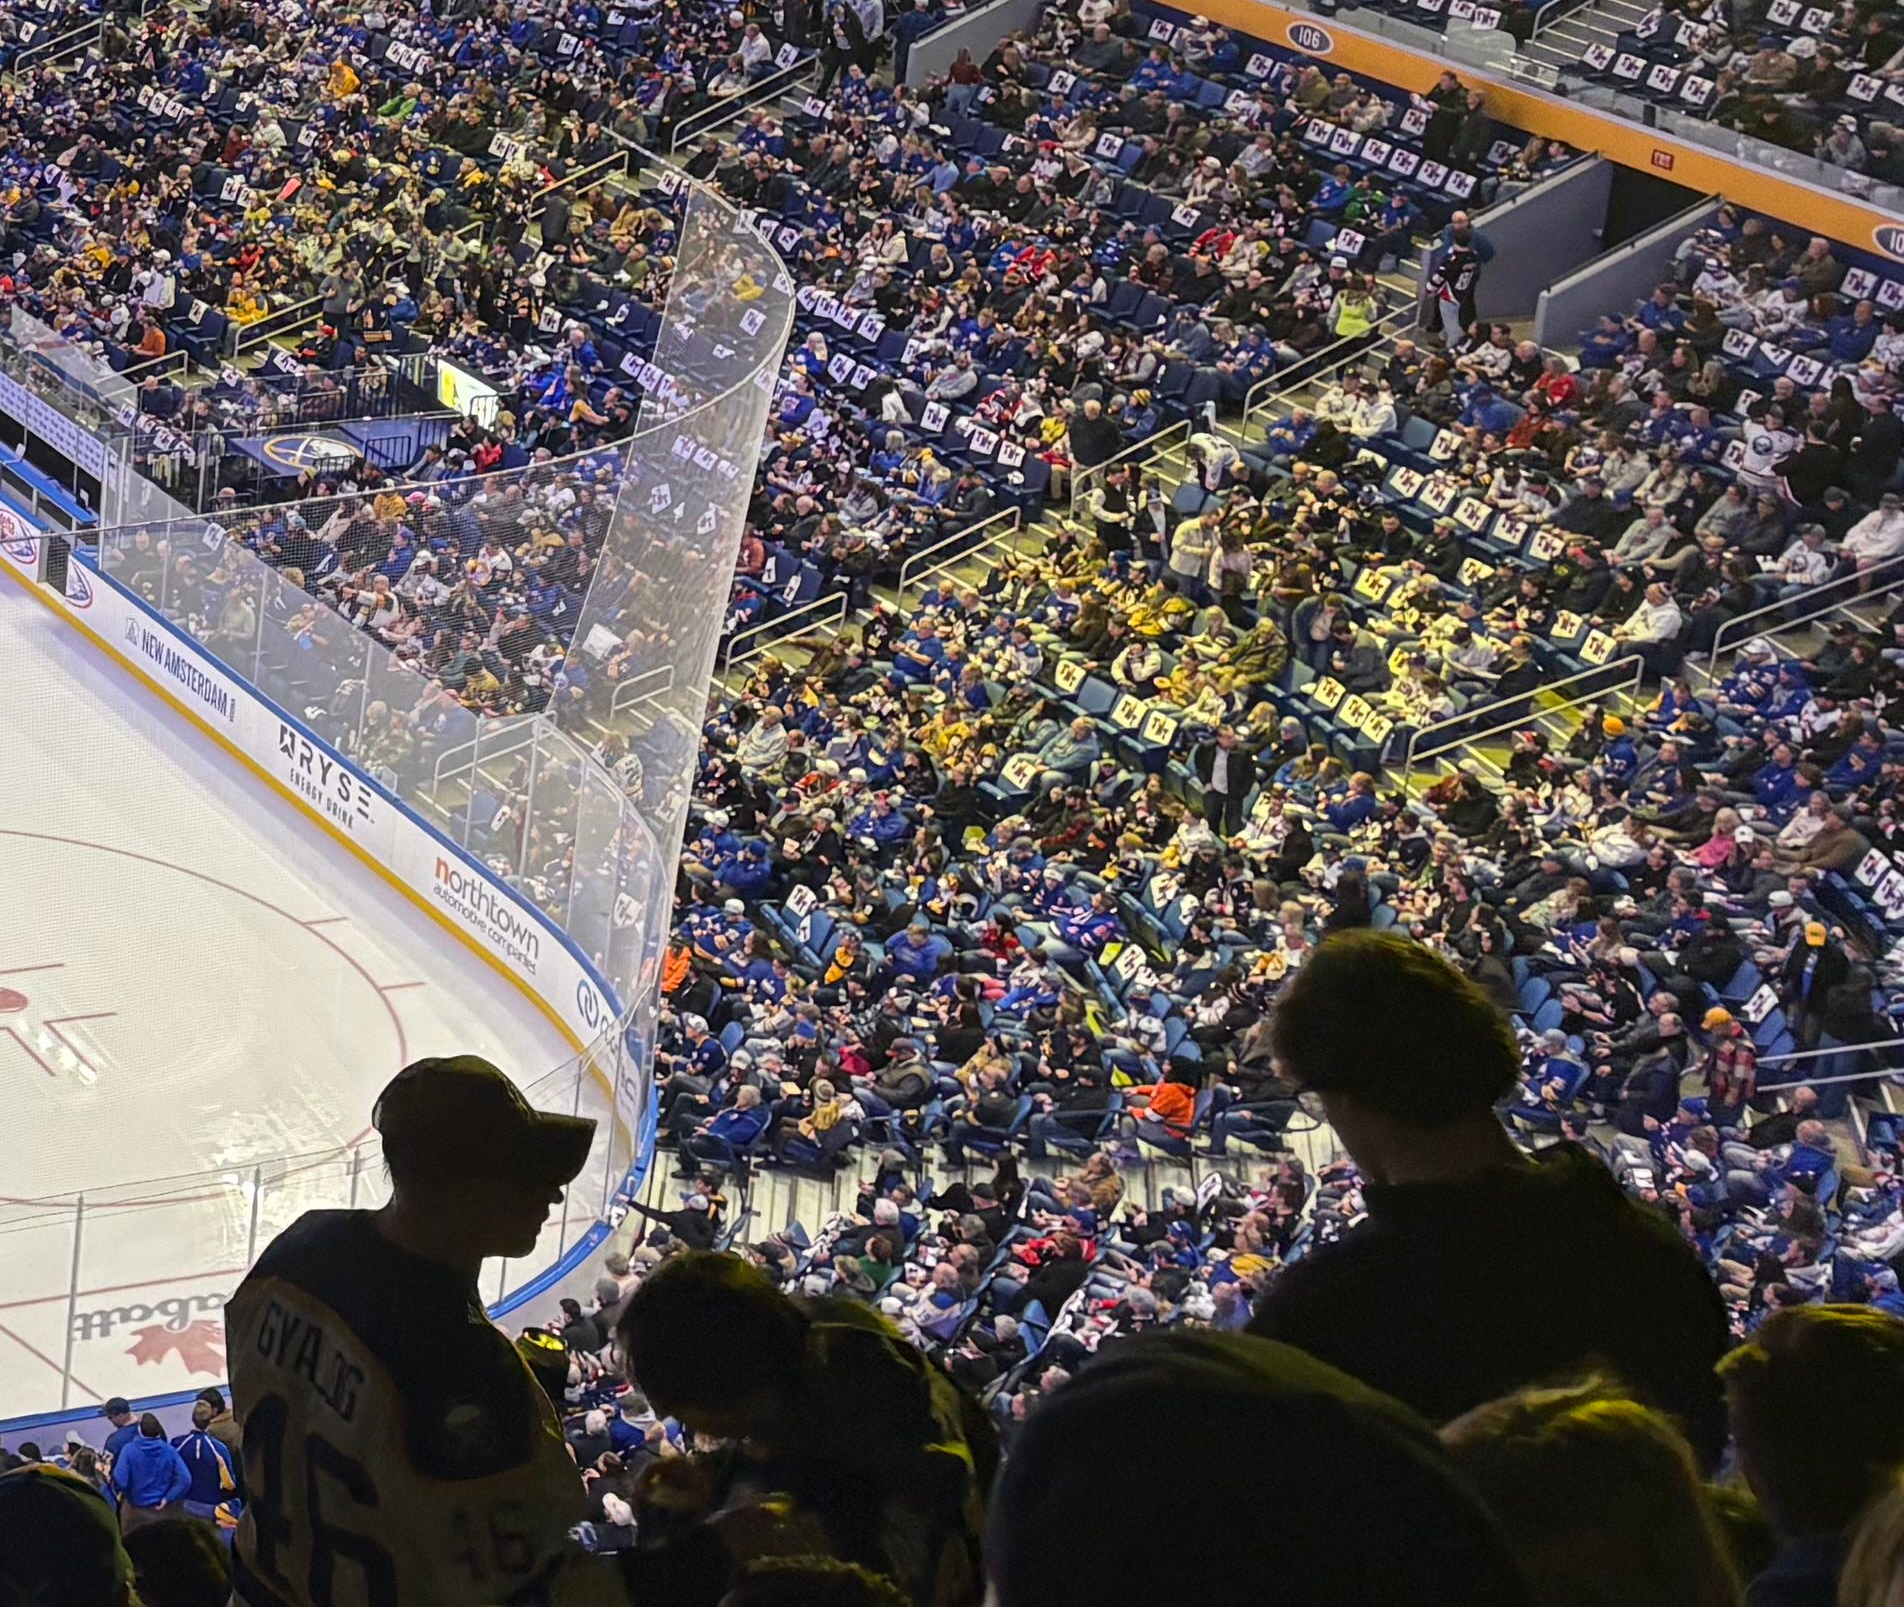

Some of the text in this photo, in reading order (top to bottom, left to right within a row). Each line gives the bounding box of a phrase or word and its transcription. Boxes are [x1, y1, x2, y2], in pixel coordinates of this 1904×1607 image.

[1297, 25, 1321, 46] 106
[142, 628, 228, 716] NEW AMSTERDAM
[290, 768, 353, 829] ENERGY DRINK
[433, 883, 536, 976] automotive companies
[436, 858, 539, 961] northtown
